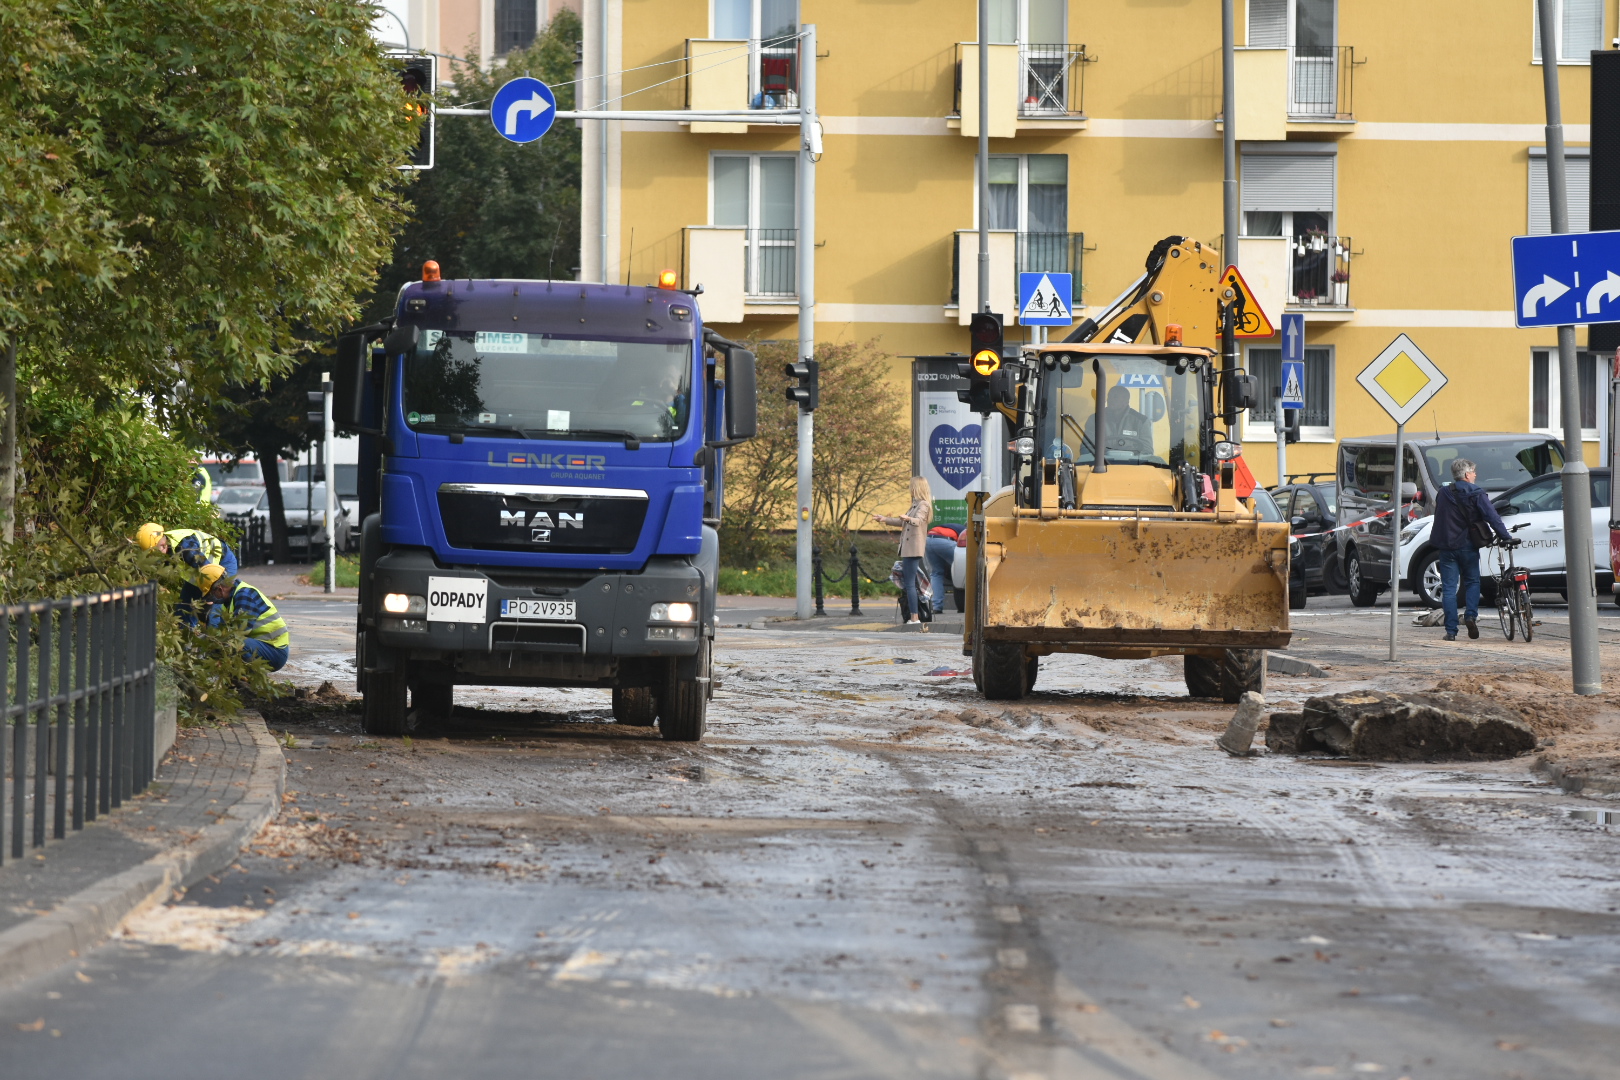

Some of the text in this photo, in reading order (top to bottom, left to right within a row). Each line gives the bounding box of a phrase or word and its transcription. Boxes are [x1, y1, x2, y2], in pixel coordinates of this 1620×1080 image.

[488, 451, 606, 471] LENKER
[500, 510, 584, 529] MAN
[1521, 540, 1558, 548] CAPTUR
[430, 591, 485, 608] ODPADY
[509, 602, 573, 616] PO 2V935
